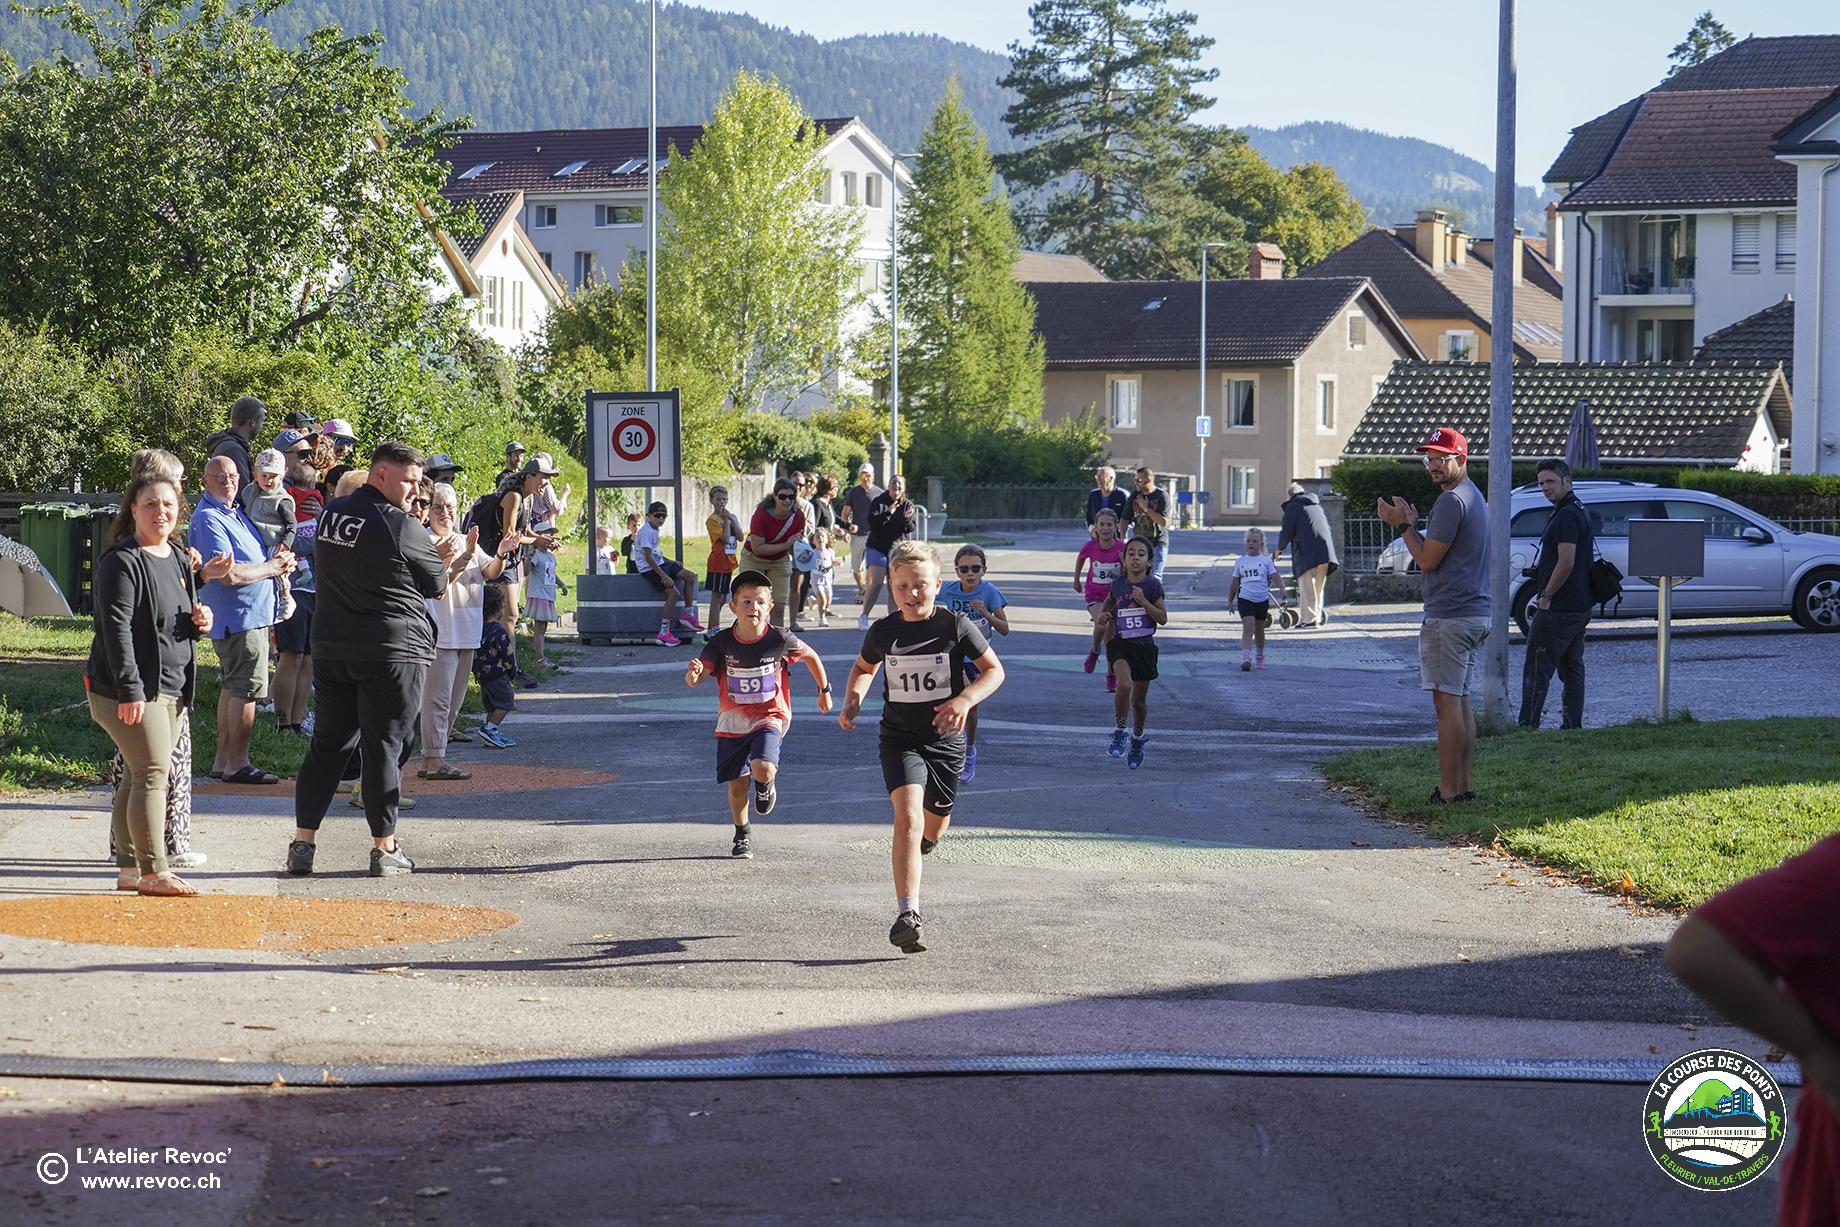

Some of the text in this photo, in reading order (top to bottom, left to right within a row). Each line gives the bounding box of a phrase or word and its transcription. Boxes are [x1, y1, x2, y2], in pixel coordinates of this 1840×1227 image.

[621, 407, 646, 416] ZONE
[625, 431, 643, 448] 30
[318, 510, 366, 543] NG
[317, 535, 355, 548] Menuiserie
[1244, 569, 1259, 578] 115
[1125, 617, 1142, 629] 55
[740, 678, 761, 693] 59
[899, 672, 937, 692] 116
